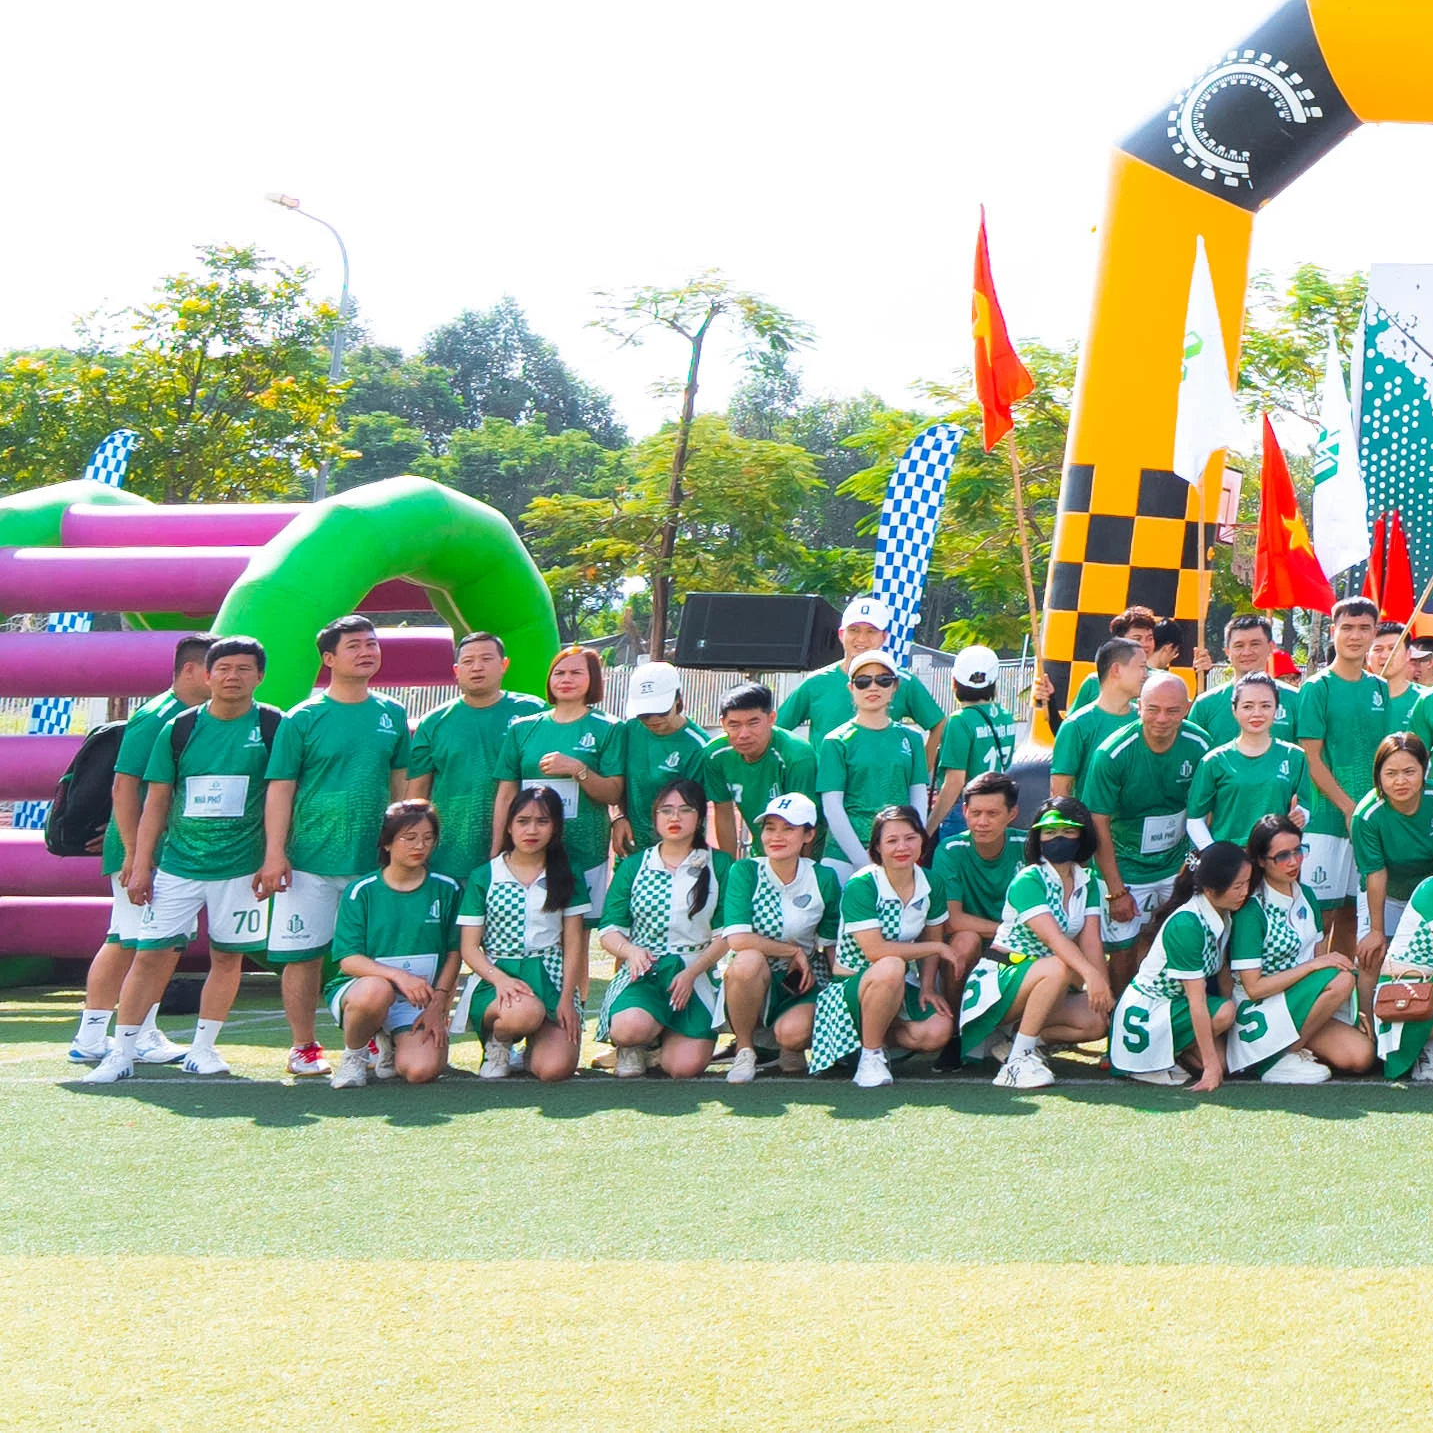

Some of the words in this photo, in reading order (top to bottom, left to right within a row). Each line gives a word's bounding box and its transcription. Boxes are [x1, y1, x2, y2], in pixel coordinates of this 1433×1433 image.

[776, 798, 792, 809] H
[232, 908, 261, 935] 70
[1122, 1004, 1150, 1054] S
[1235, 999, 1269, 1043] S
